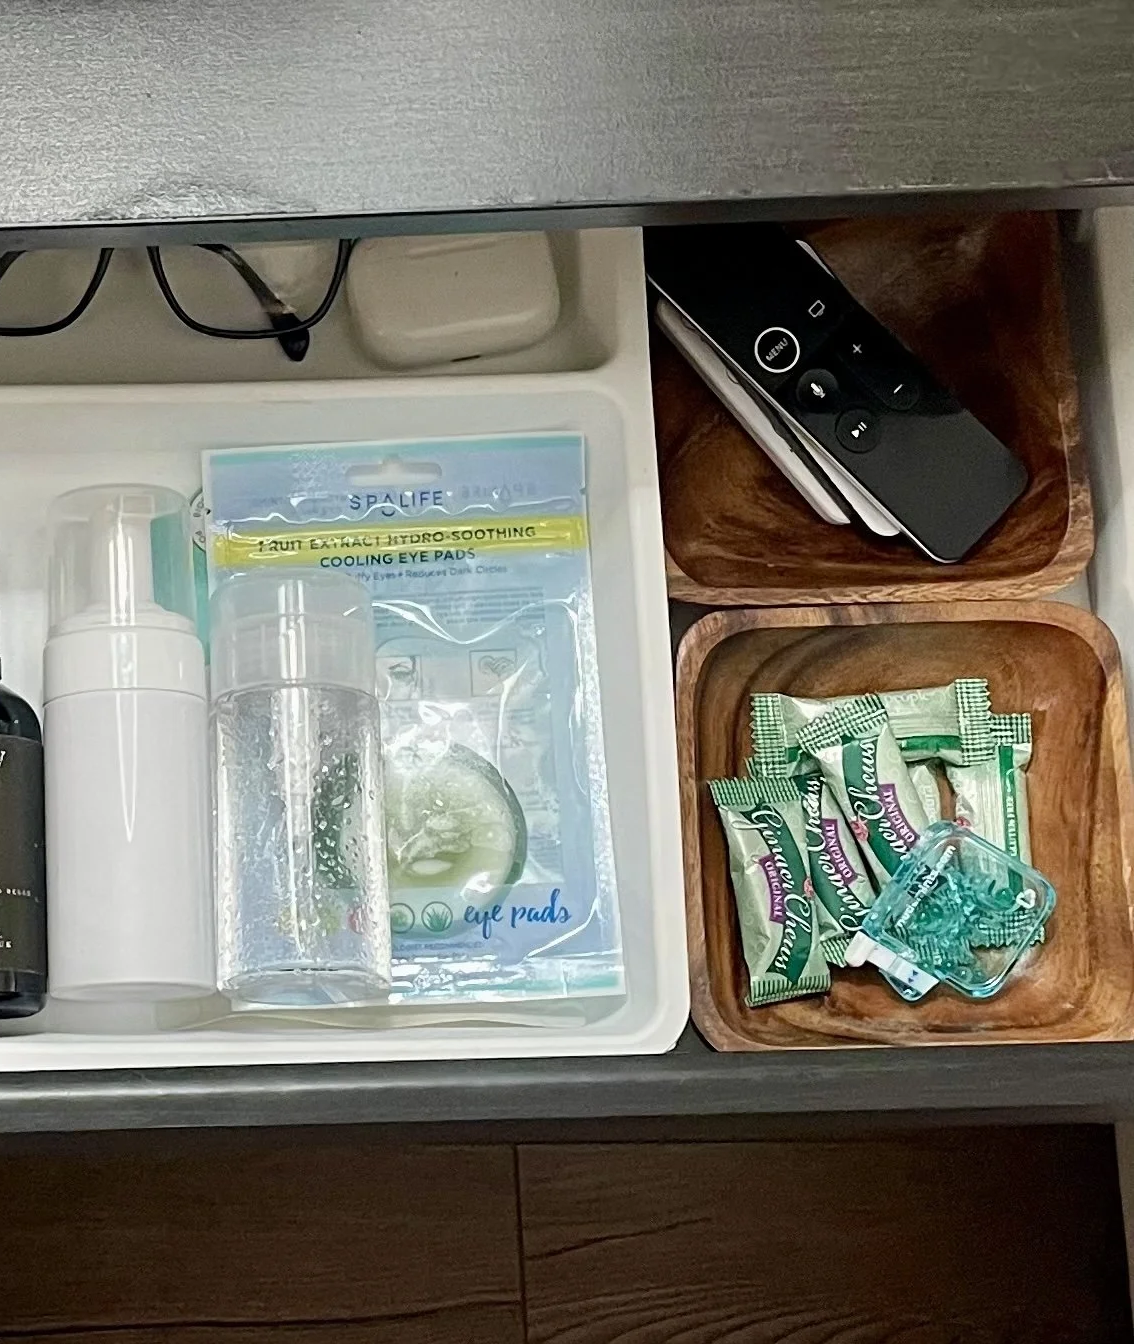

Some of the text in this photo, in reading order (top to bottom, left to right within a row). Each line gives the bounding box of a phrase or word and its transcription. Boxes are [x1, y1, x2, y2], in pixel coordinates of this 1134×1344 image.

[765, 337, 789, 362] MENU
[349, 490, 443, 517] SPALIFE
[310, 535, 380, 551] EXTRACT
[388, 526, 537, 547] HYDRO-SOOTHING
[320, 547, 476, 568] COOLING EYE PADS
[373, 569, 396, 582] Eyes
[405, 567, 447, 579] Reduces
[449, 565, 472, 577] Dark
[883, 788, 916, 844] ORIGINAL
[825, 823, 853, 879] ORIGINAL
[731, 808, 812, 971] Ginger Chews
[764, 860, 784, 919] ORIGINAL
[463, 887, 573, 940] eye pads
